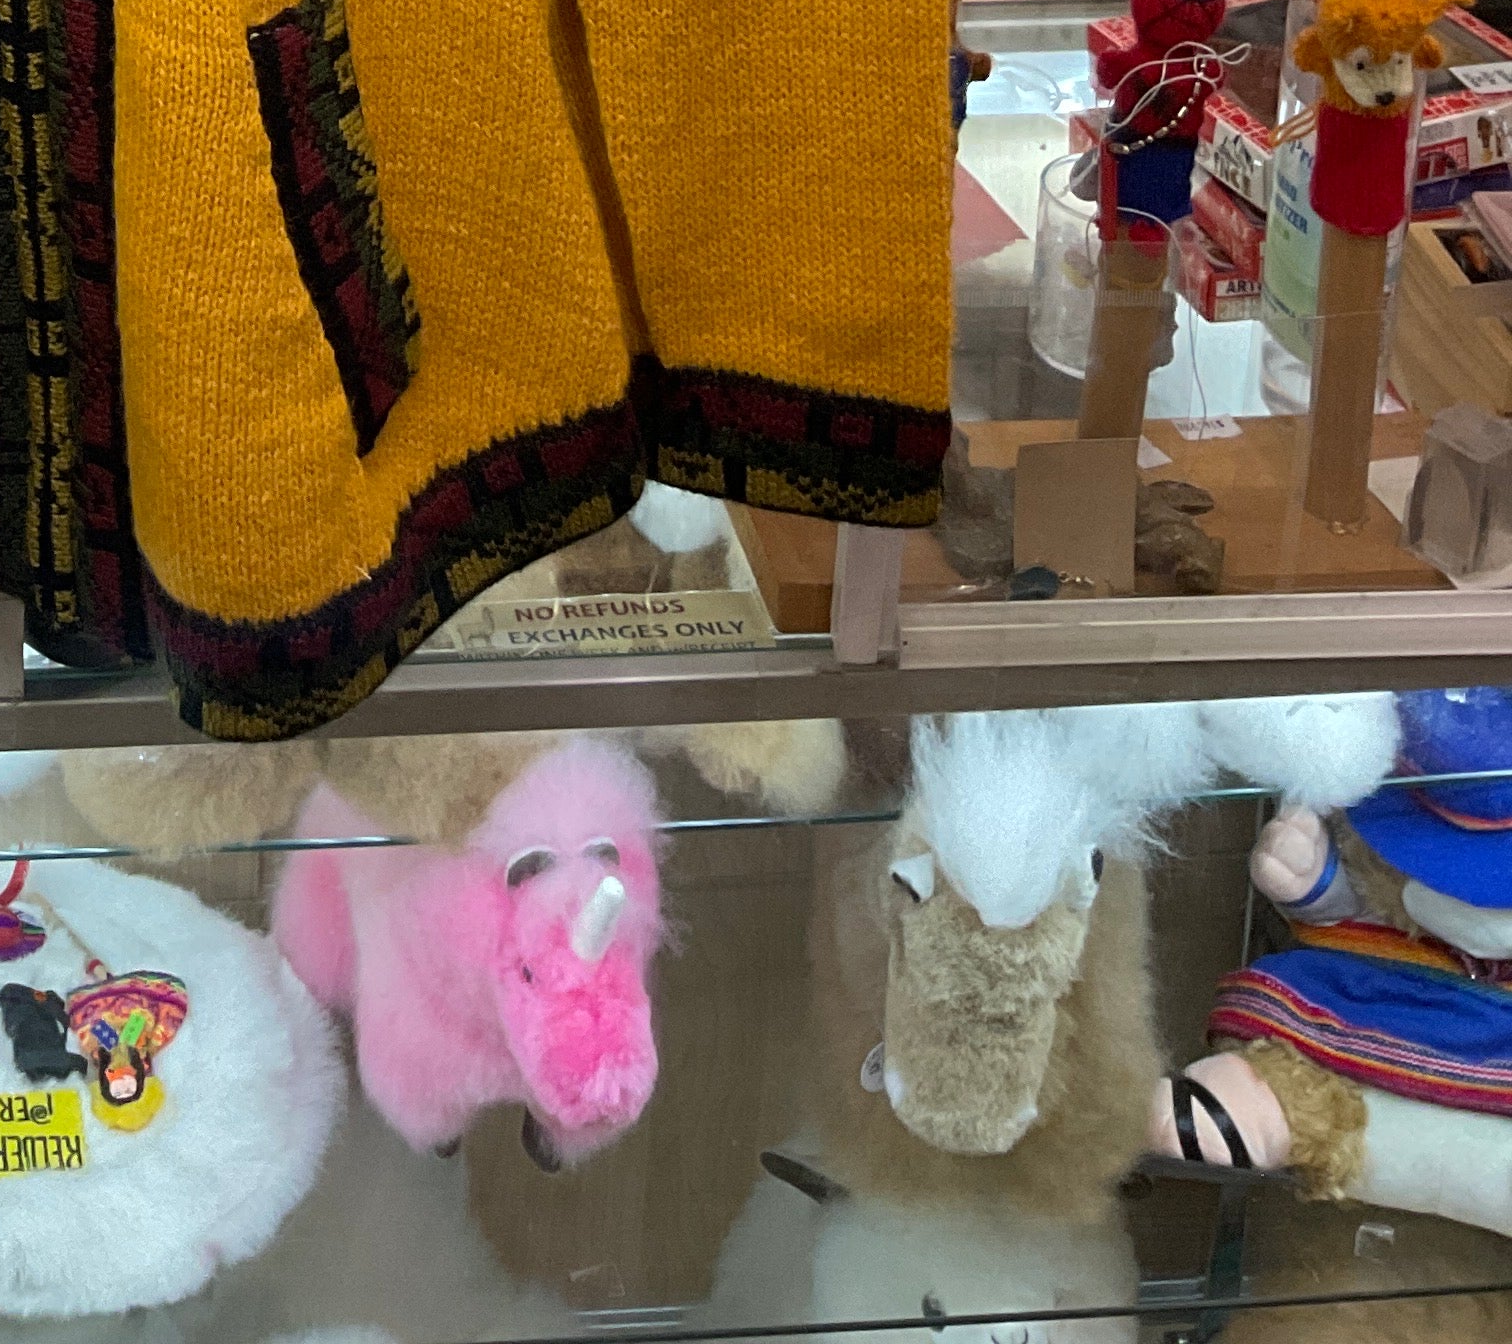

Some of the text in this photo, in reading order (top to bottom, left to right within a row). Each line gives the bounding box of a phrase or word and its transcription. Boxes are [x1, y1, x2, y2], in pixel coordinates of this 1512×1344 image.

[514, 598, 685, 622] NO REFUNDS
[509, 620, 745, 645] EXCHANGES ONLY
